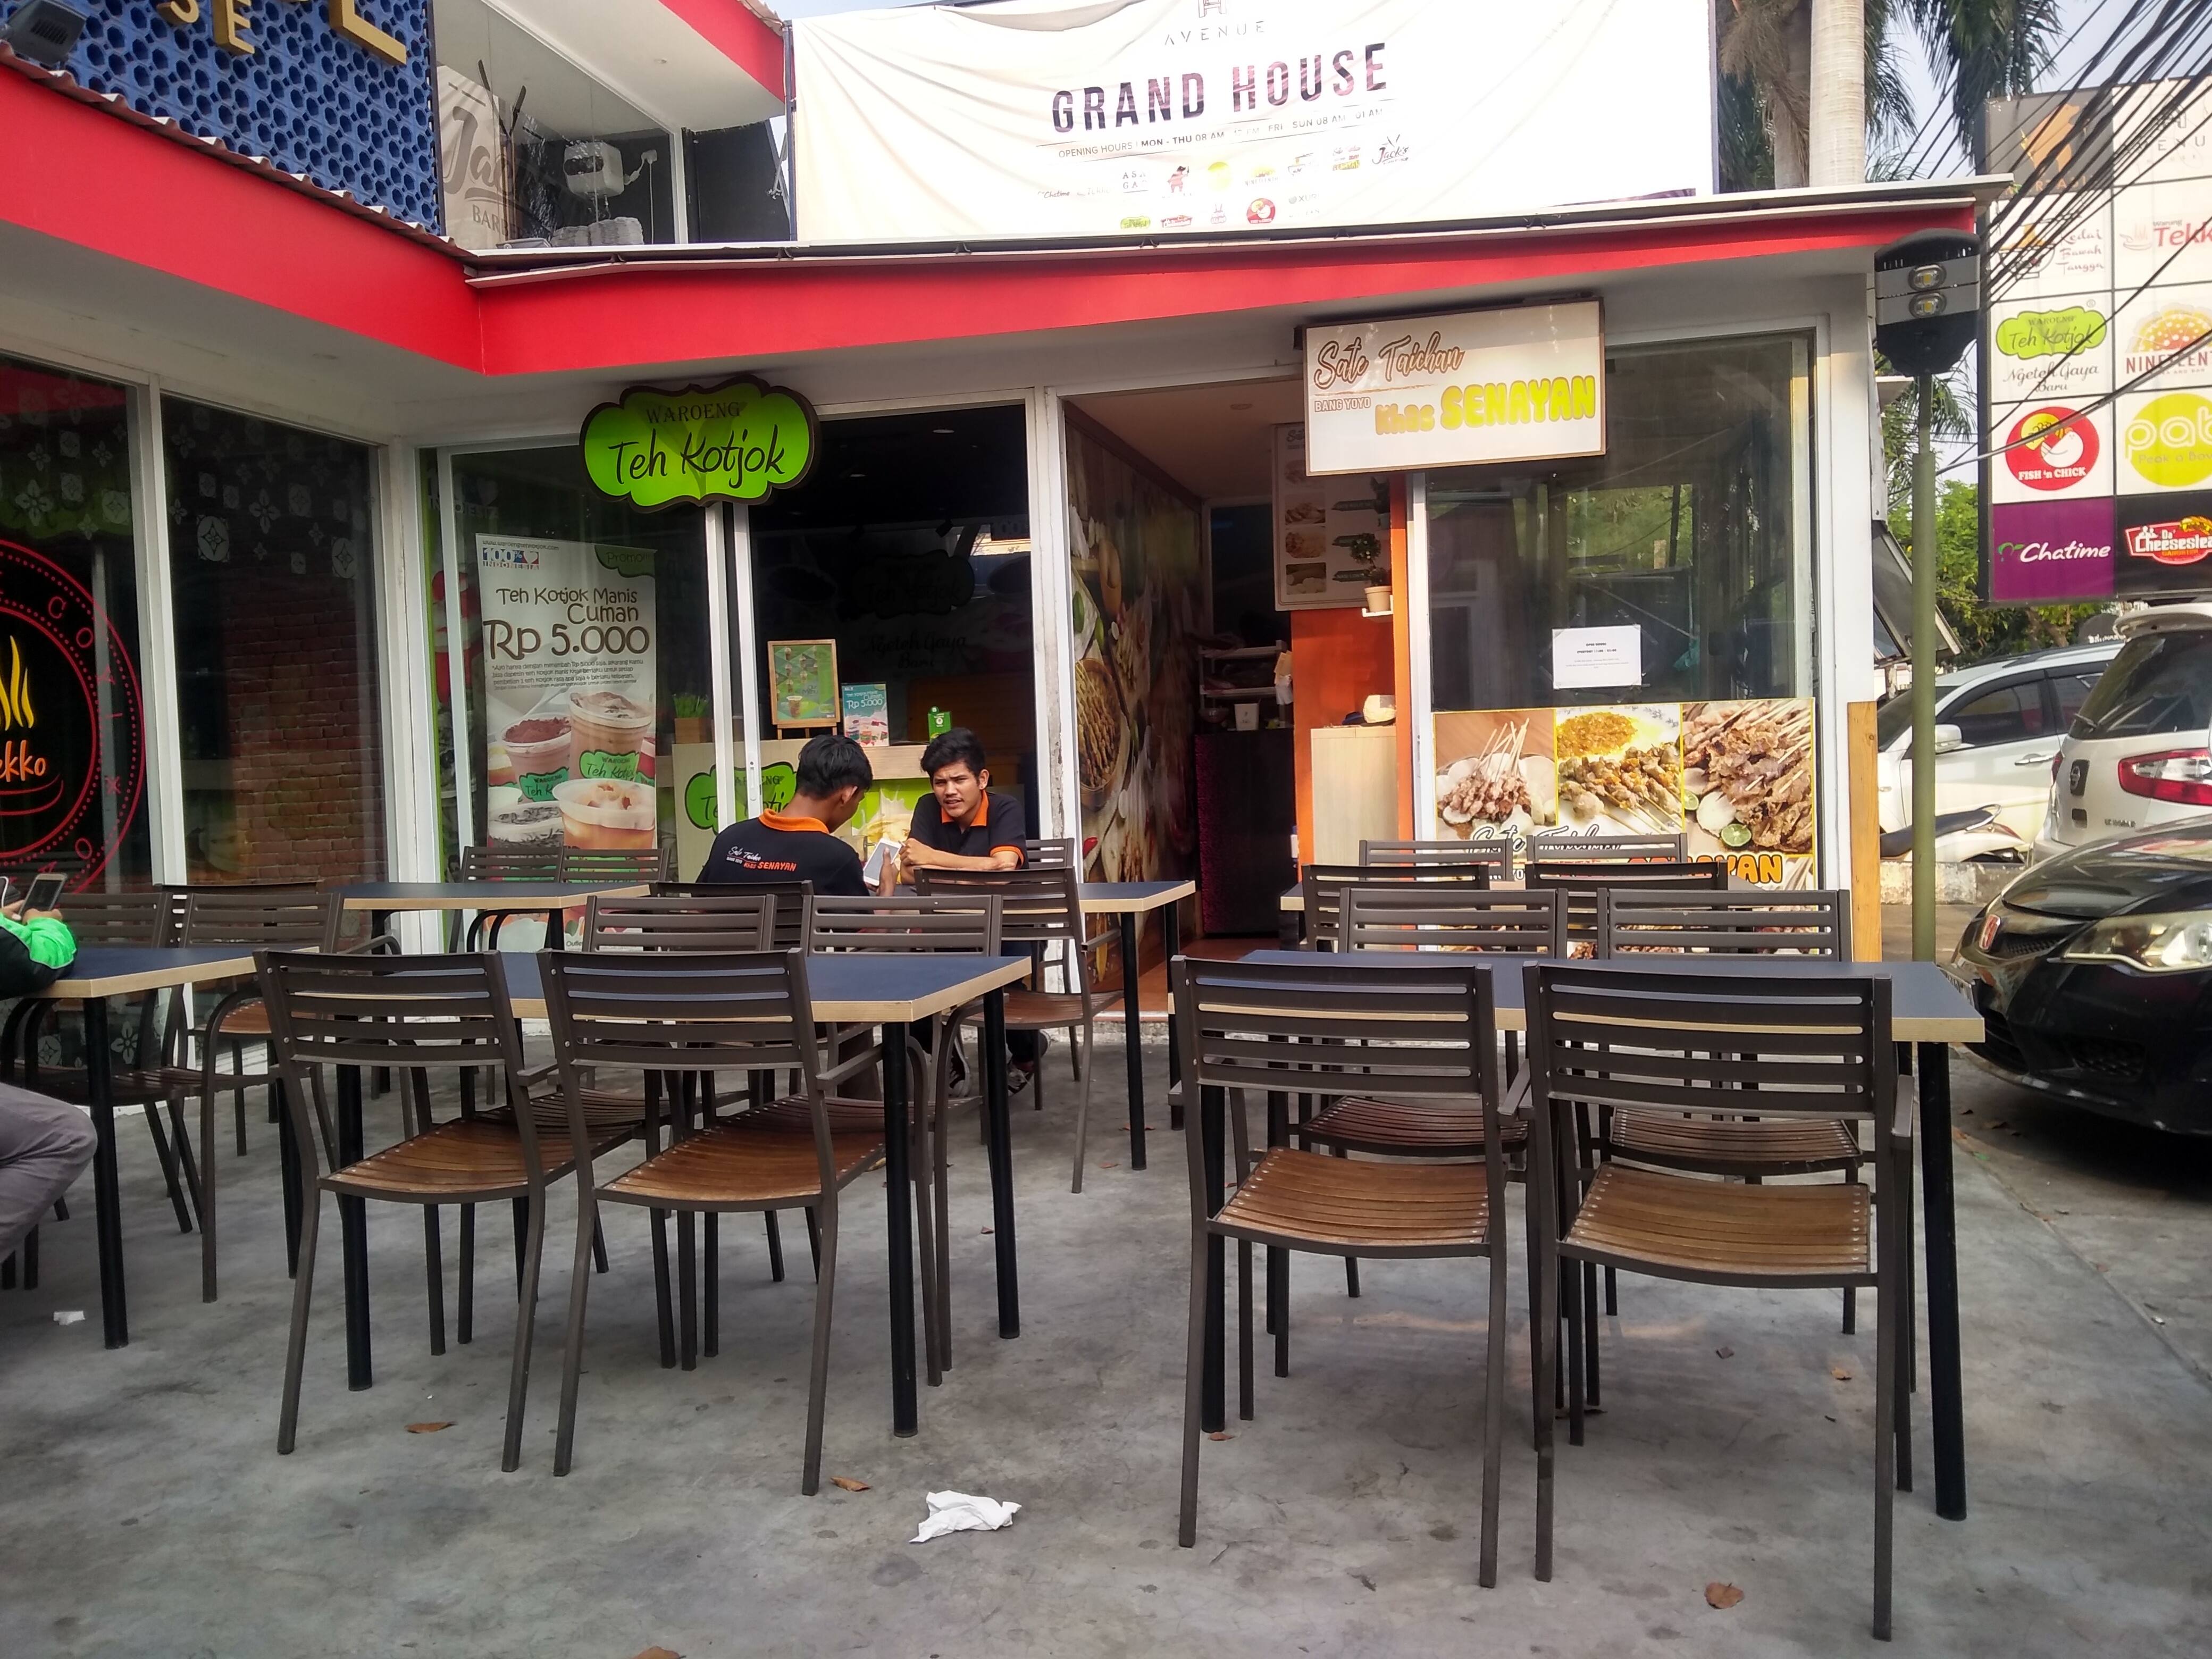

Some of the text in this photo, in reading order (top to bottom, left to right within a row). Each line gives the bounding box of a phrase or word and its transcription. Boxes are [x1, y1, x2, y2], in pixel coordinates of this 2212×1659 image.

[1164, 21, 1266, 46] AVENUE
[1052, 42, 1387, 133] GRAND HOUSE
[1059, 146, 1098, 158] OPENING
[1101, 141, 1133, 153] HOURS
[1141, 138, 1163, 147] MON
[1172, 135, 1192, 145] THU
[1268, 123, 1283, 132] FRI
[1292, 119, 1313, 129] SUN
[1317, 116, 1328, 125] 08
[1331, 115, 1346, 123] AM
[1368, 108, 1383, 117] AM
[2027, 316, 2075, 326] WAROENG
[2009, 324, 2092, 350] Teh Kotjok
[1313, 331, 1465, 390] Sate Taichan
[2002, 362, 2099, 387] Ngeteh Gaya
[2035, 381, 2068, 392] Baru
[646, 401, 740, 423] WAROENG
[1314, 397, 1371, 412] BANG YOYO
[1440, 375, 1596, 430] SENAYAN
[608, 424, 785, 489] Teh Kotjok
[2018, 470, 2041, 481] FISH
[2054, 467, 2087, 478] CHICK
[483, 547, 523, 562] 100%
[2020, 541, 2111, 564] Chatime
[496, 587, 638, 605] Teh Kotjok Manis
[567, 603, 639, 625] Cuman
[483, 619, 650, 660] Rp 5.000
[847, 698, 883, 709] Rp 5.000
[586, 763, 606, 777] Teh
[525, 785, 542, 797] Teh
[757, 861, 797, 872] SENAYAN
